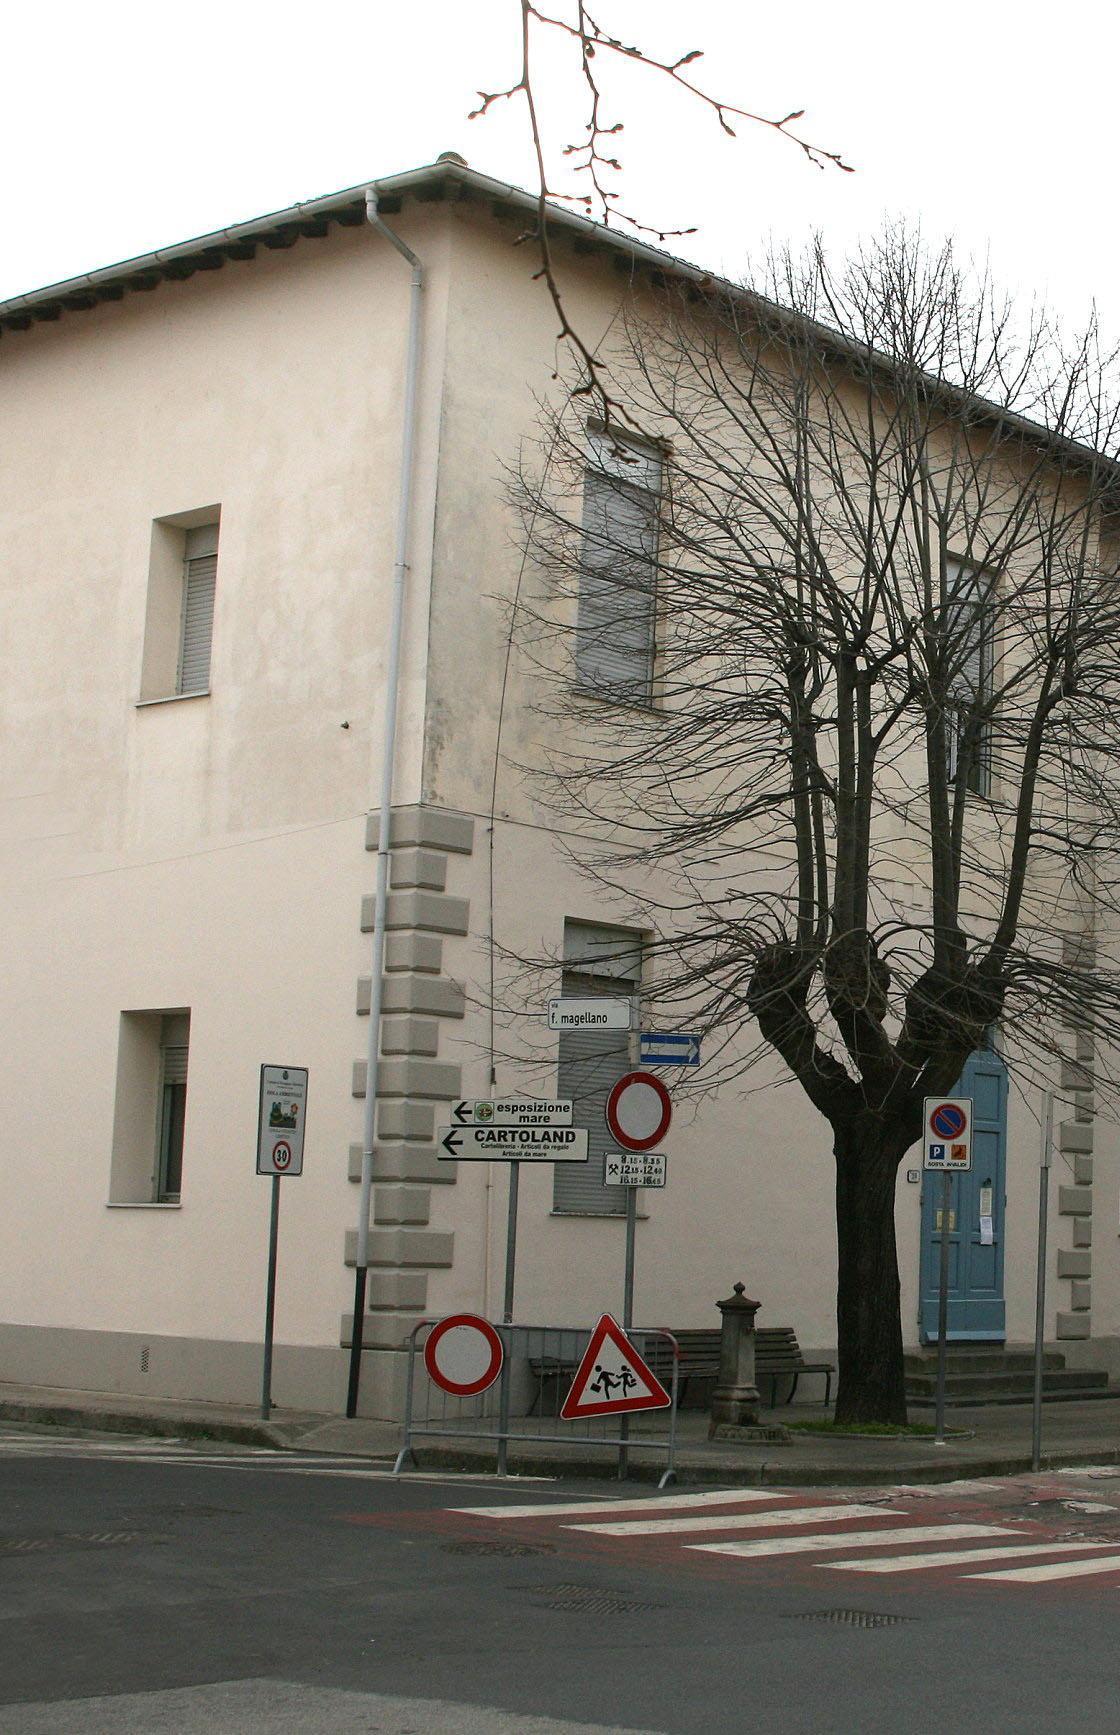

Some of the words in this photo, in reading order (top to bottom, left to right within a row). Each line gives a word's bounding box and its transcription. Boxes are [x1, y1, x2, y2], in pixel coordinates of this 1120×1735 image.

[551, 1013, 558, 1024] f.
[561, 1012, 608, 1026] magellano
[496, 1102, 571, 1115] esposizione
[519, 1114, 551, 1123] mare
[474, 1130, 577, 1143] CARTOLAND
[276, 1149, 287, 1162] 30
[933, 1146, 941, 1157] P
